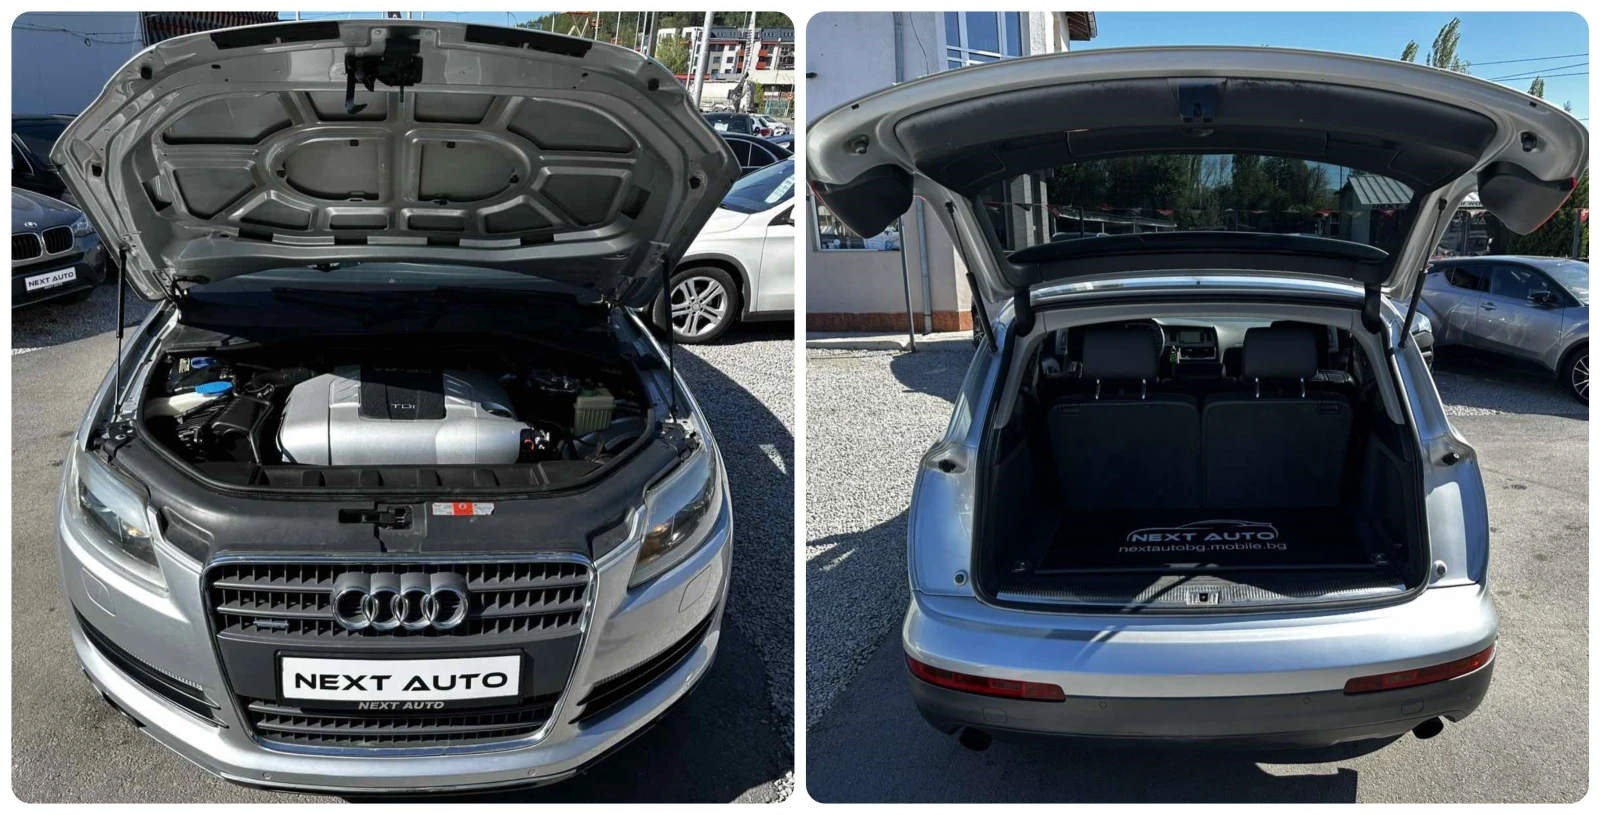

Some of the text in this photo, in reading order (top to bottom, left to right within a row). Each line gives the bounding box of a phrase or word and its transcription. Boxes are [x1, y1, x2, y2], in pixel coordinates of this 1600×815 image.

[28, 278, 50, 287] NEXT
[53, 272, 74, 281] AUTO
[1131, 531, 1275, 542] NEXT AUTO
[1119, 542, 1287, 553] nextautobg.mobile.bg
[295, 671, 508, 691] NEXT AUTO
[358, 701, 445, 710] NEXT AUTO
